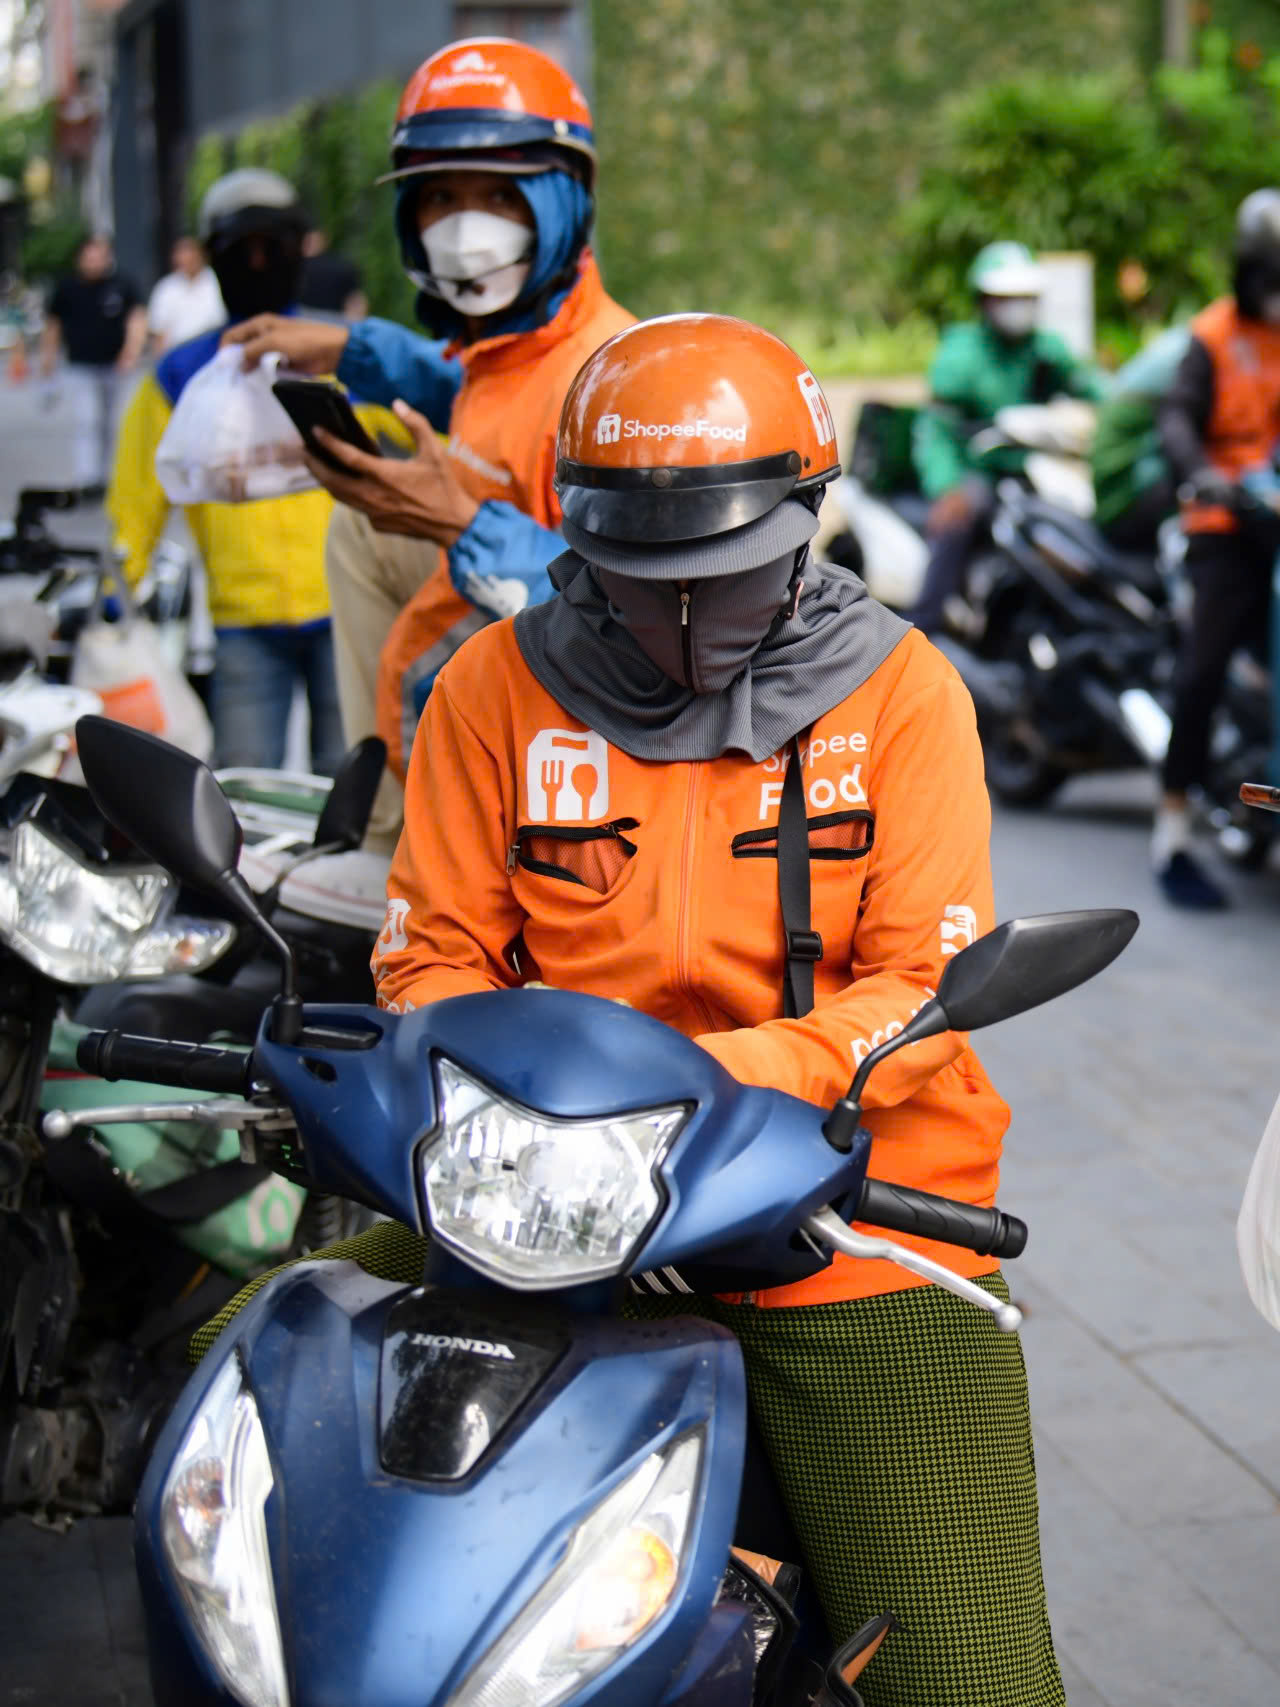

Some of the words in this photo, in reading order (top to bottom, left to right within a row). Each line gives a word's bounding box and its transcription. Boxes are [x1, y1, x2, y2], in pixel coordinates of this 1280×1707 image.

[623, 420, 747, 442] ShopeeFood
[759, 764, 867, 820] Fod
[410, 1333, 515, 1360] HONDA
